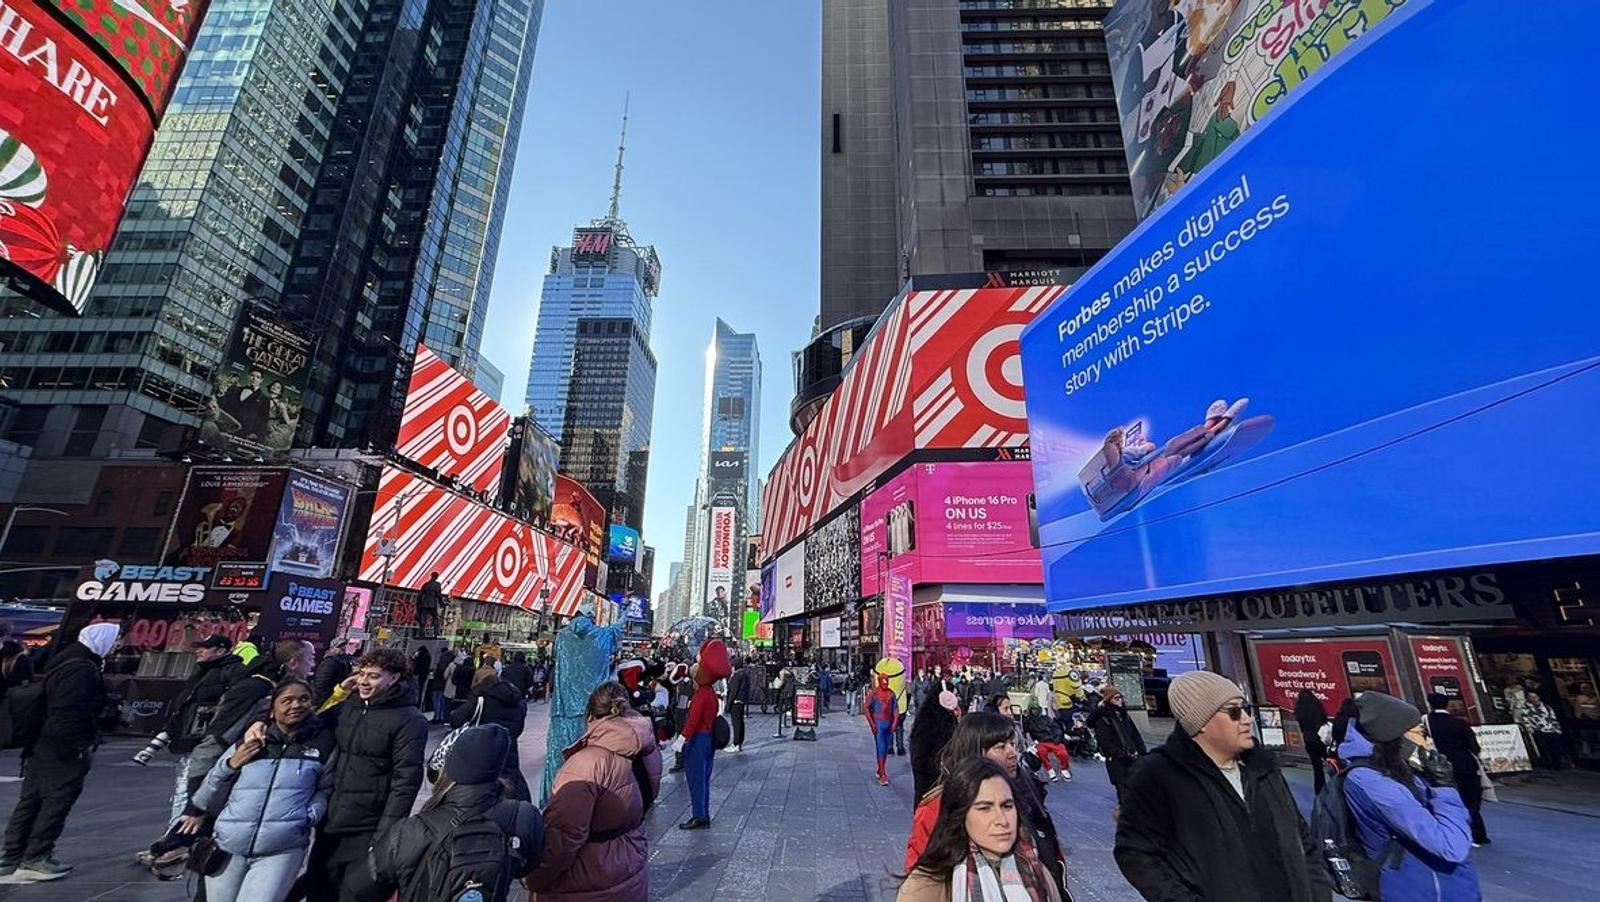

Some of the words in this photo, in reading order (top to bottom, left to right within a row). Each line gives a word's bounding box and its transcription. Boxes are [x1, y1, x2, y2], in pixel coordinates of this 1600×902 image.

[1057, 291, 1111, 342] Forbes
[1113, 241, 1175, 298] makes
[1177, 174, 1251, 248] digital
[1010, 269, 1060, 278] MARRIOTT
[1062, 285, 1163, 368] membership
[1167, 273, 1180, 294] a
[1184, 194, 1290, 281] success
[1011, 278, 1056, 286] MARQUIS
[243, 327, 264, 349] THE
[1065, 360, 1101, 396] story
[1104, 335, 1141, 369] with
[1142, 294, 1211, 344] Stripe.
[944, 496, 951, 505] 4
[952, 496, 986, 505] iPhone
[987, 496, 999, 505] 16
[1000, 496, 1018, 504] Pro
[945, 508, 965, 519] ON
[969, 508, 987, 519] US
[946, 522, 952, 530] 4
[953, 522, 972, 530] lines
[974, 522, 985, 530] for
[987, 521, 1002, 530] $25
[722, 511, 731, 569] YOUNGBOY
[120, 565, 211, 580] BEAST
[76, 581, 206, 602] GAMES
[228, 593, 249, 601] prime
[297, 585, 337, 600] BEAST
[1158, 598, 1233, 625] EAGLE
[1242, 572, 1504, 619] OUTFITTERS
[280, 596, 334, 614] GAMES
[895, 601, 905, 641] WISH
[1281, 654, 1317, 664] todaytix
[1278, 669, 1326, 680] Broadway's
[1274, 680, 1292, 688] best
[1293, 680, 1304, 689] tix
[1305, 681, 1315, 689] at
[1316, 682, 1336, 690] your
